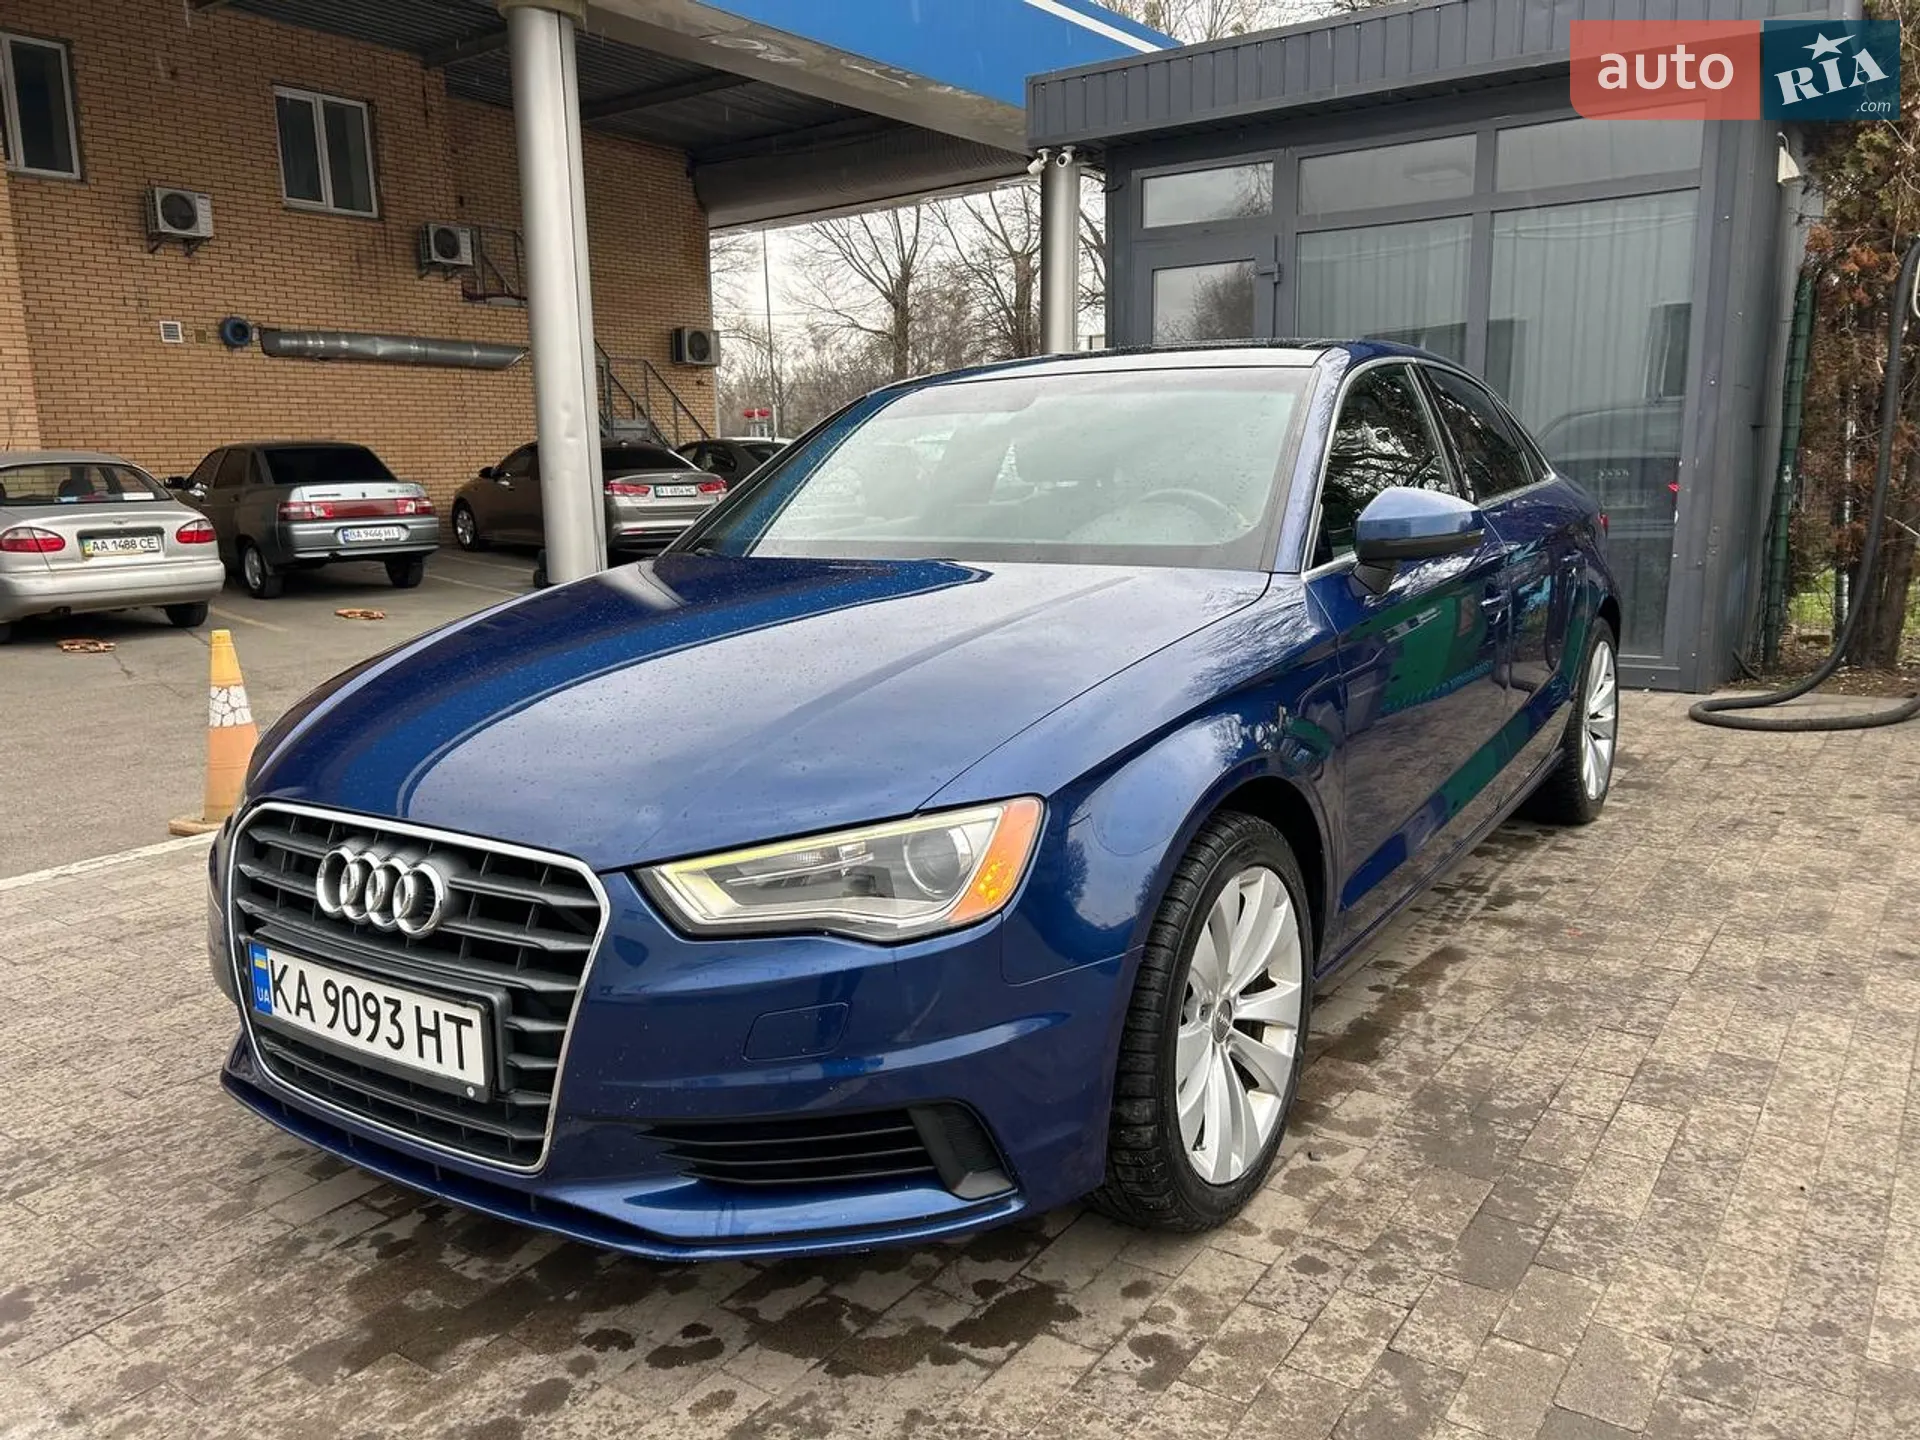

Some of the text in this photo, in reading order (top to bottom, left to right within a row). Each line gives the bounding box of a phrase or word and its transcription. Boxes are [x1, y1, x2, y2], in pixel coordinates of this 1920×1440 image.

[92, 537, 157, 552] AA 1488 CE
[256, 988, 271, 1003] UA
[269, 959, 473, 1071] KA 9093 HT
